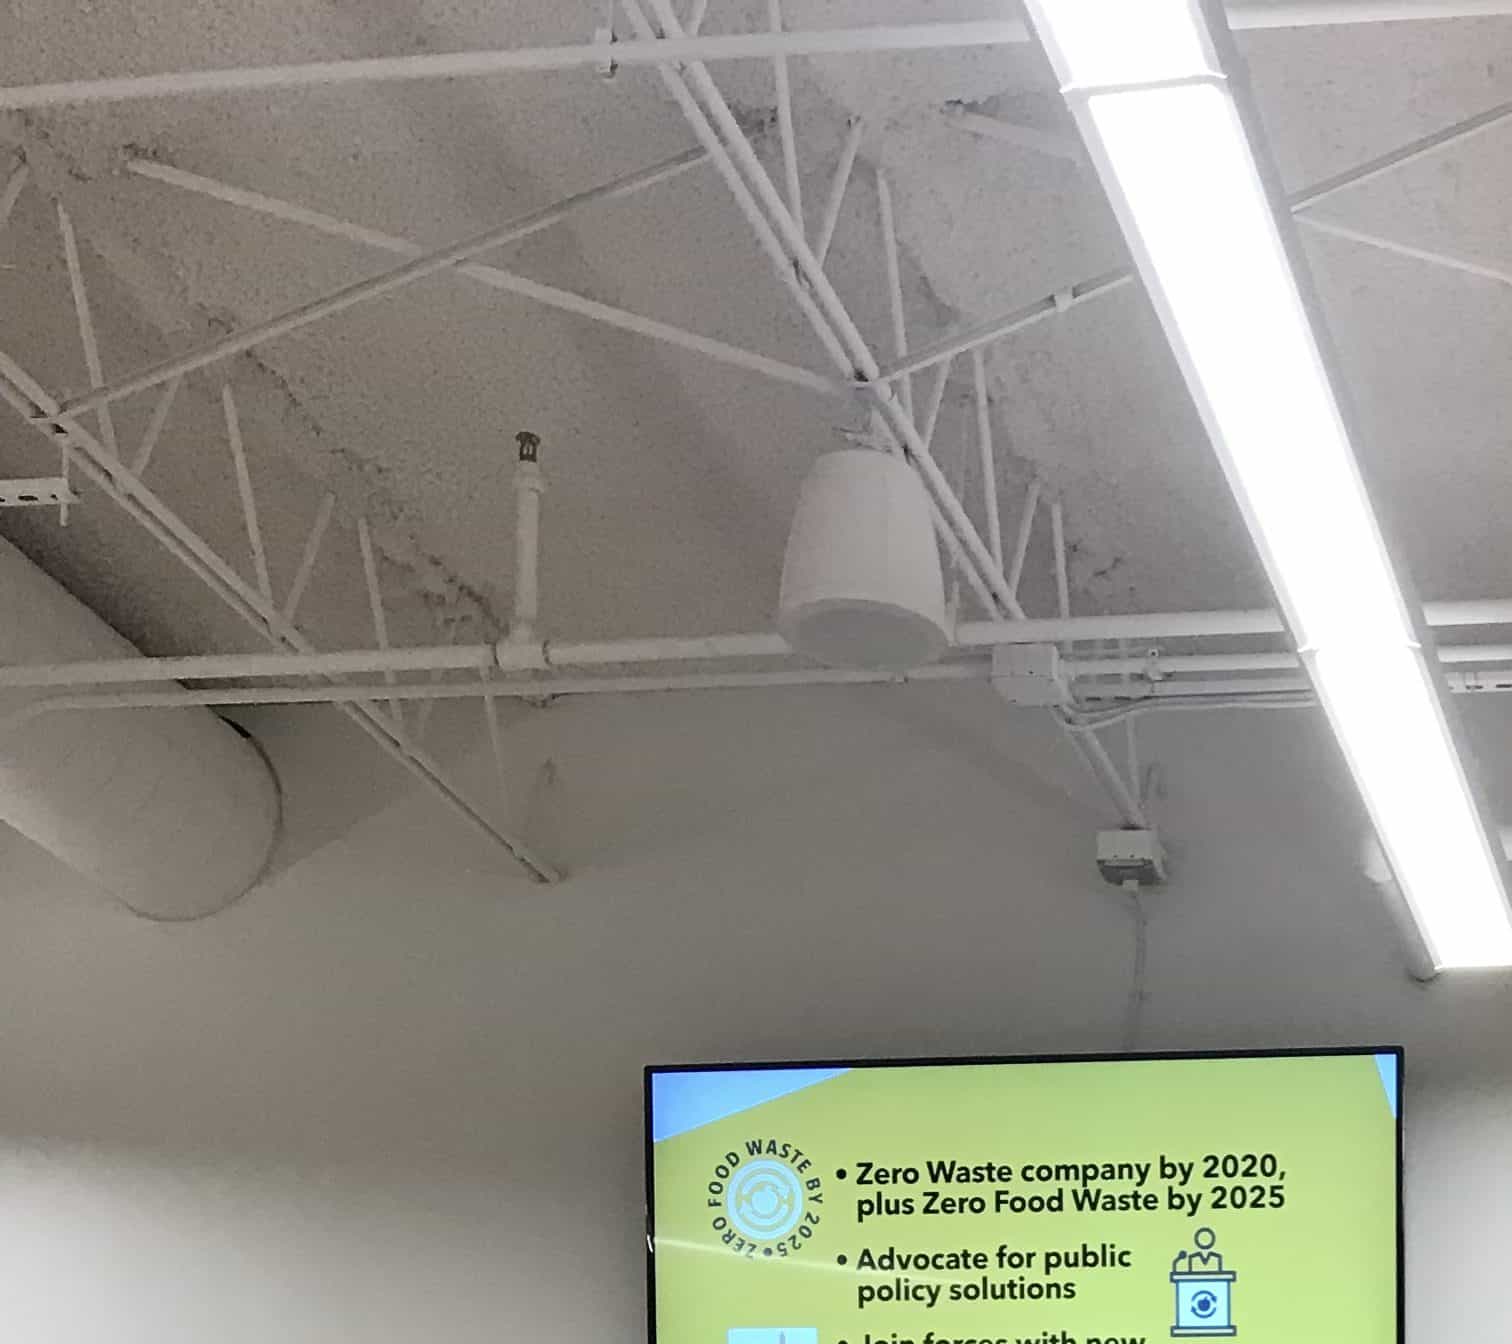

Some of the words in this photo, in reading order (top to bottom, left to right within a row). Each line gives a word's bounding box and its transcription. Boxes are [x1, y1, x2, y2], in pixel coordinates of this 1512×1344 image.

[745, 1139, 812, 1174] WASTE
[855, 1162, 920, 1185] Zero
[926, 1160, 1013, 1183] Waste
[1020, 1161, 1151, 1188] company
[1159, 1155, 1195, 1184] by
[1201, 1153, 1287, 1180] 2020,
[707, 1151, 740, 1207] FOOD
[806, 1177, 823, 1204] BY
[857, 1192, 915, 1223] plus
[922, 1191, 986, 1216] Zero
[994, 1188, 1064, 1214] Food
[1071, 1188, 1159, 1211] Waste
[1167, 1186, 1202, 1217] by
[1210, 1186, 1286, 1210] 2025
[712, 1216, 757, 1258] ZERO
[776, 1211, 820, 1257] 2025
[856, 1247, 989, 1271] Advocate
[996, 1245, 1036, 1269] for
[1044, 1243, 1132, 1275] public
[857, 1278, 941, 1309] policy
[949, 1276, 1076, 1300] solutions
